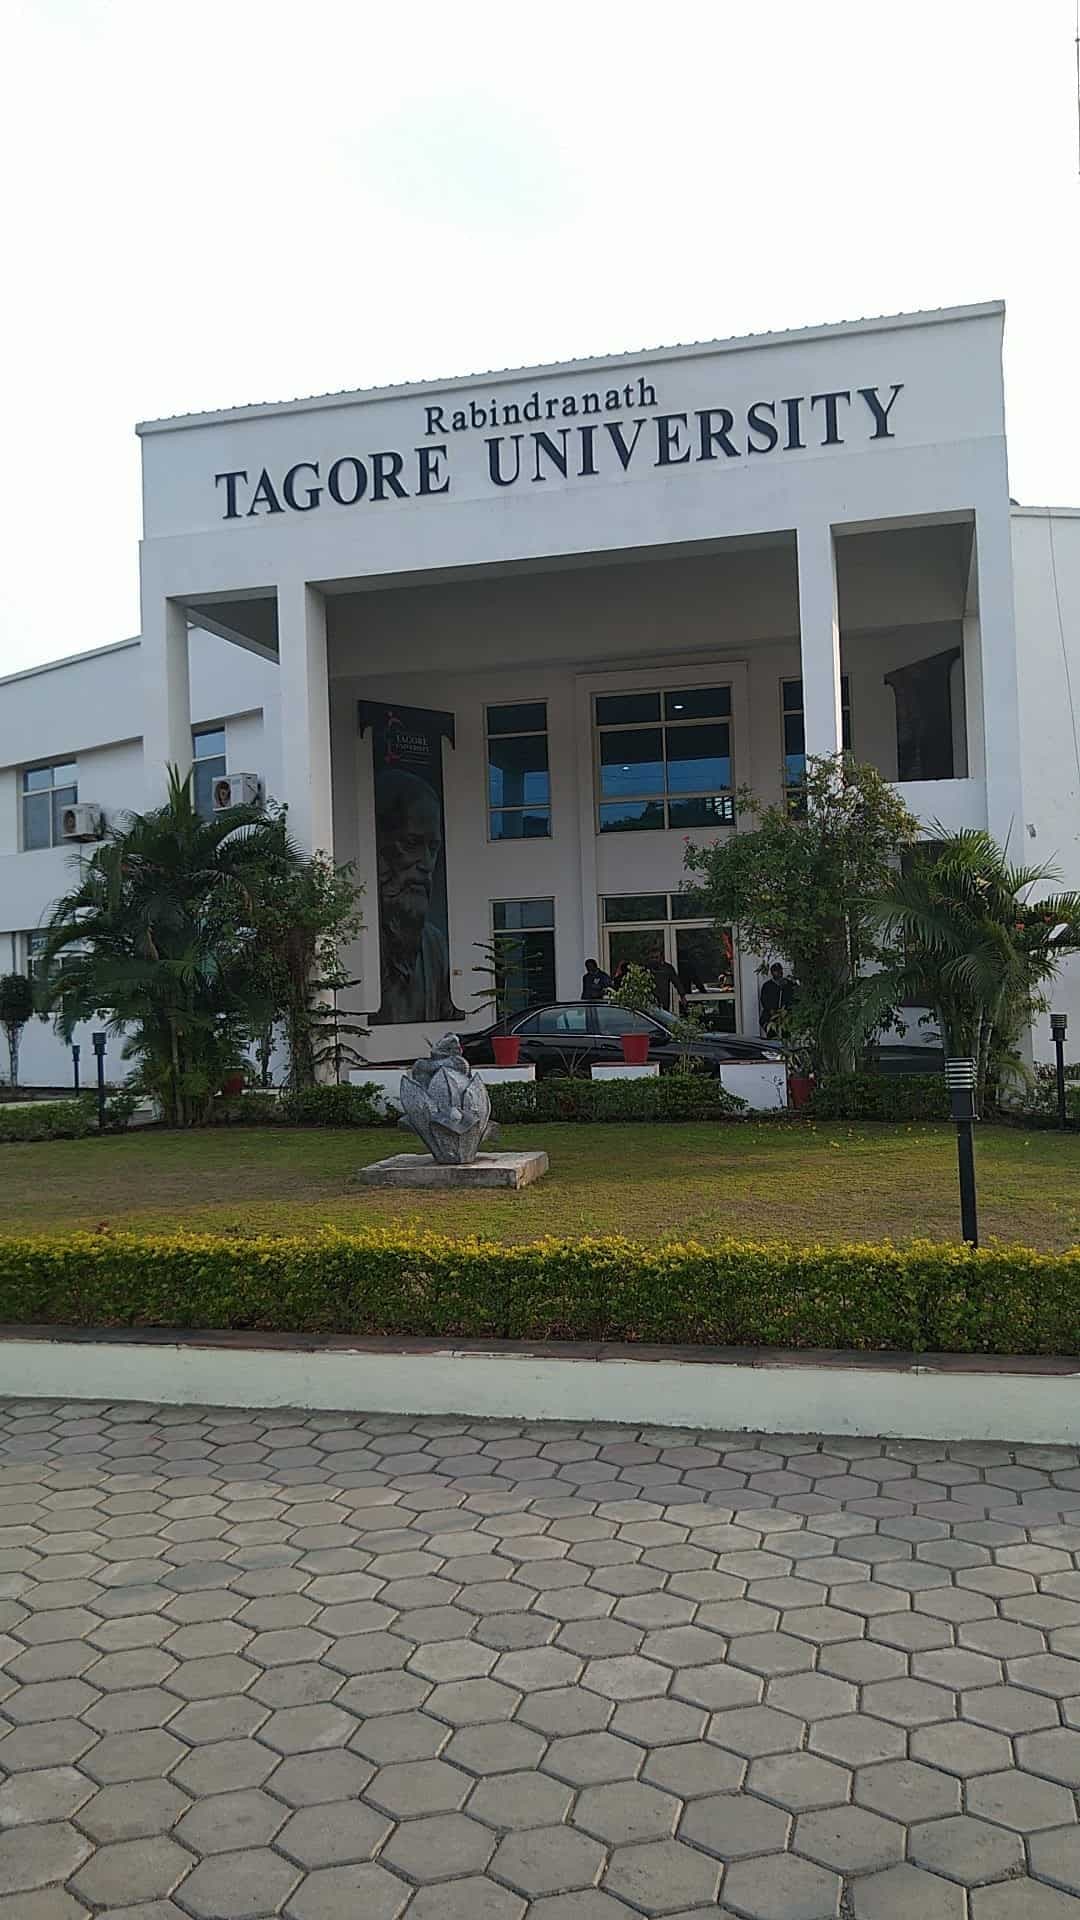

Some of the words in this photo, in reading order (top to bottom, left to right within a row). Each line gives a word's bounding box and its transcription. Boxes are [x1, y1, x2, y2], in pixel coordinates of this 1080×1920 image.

[214, 445, 450, 520] TAGORE
[484, 384, 905, 487] UNIVERSITY
[424, 378, 658, 436] Rabindranath
